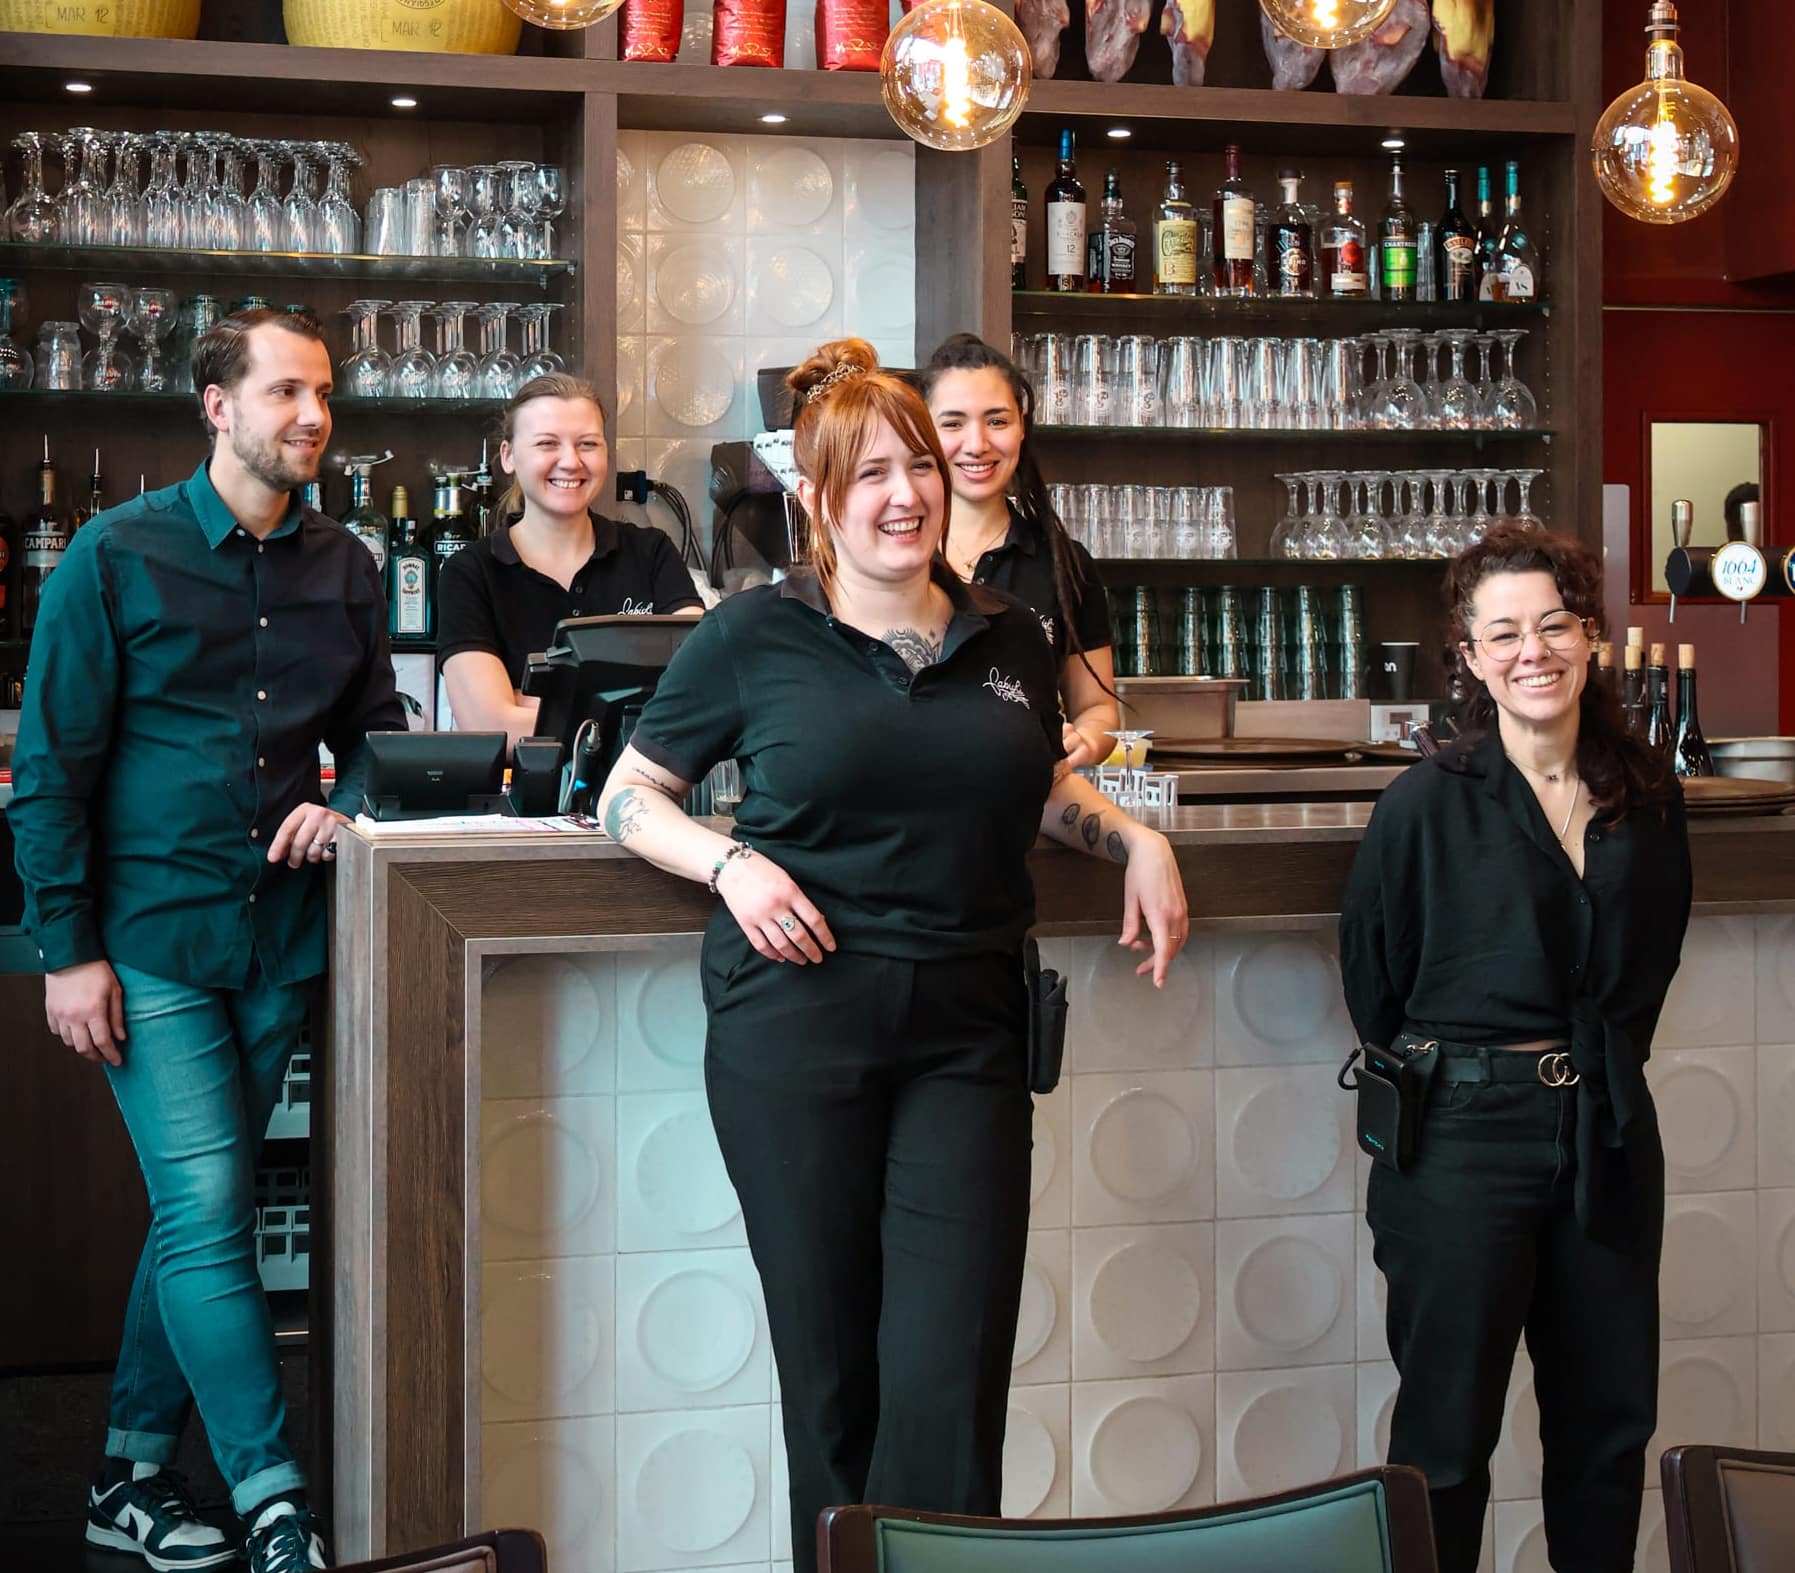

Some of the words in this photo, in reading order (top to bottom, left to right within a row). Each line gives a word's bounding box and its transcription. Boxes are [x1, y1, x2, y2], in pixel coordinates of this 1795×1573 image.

[56, 7, 86, 23] MAR
[94, 8, 110, 24] 12
[391, 20, 421, 35] MAR
[1066, 243, 1077, 254] 12
[1164, 263, 1176, 277] 13
[25, 537, 66, 549] CAMPARI
